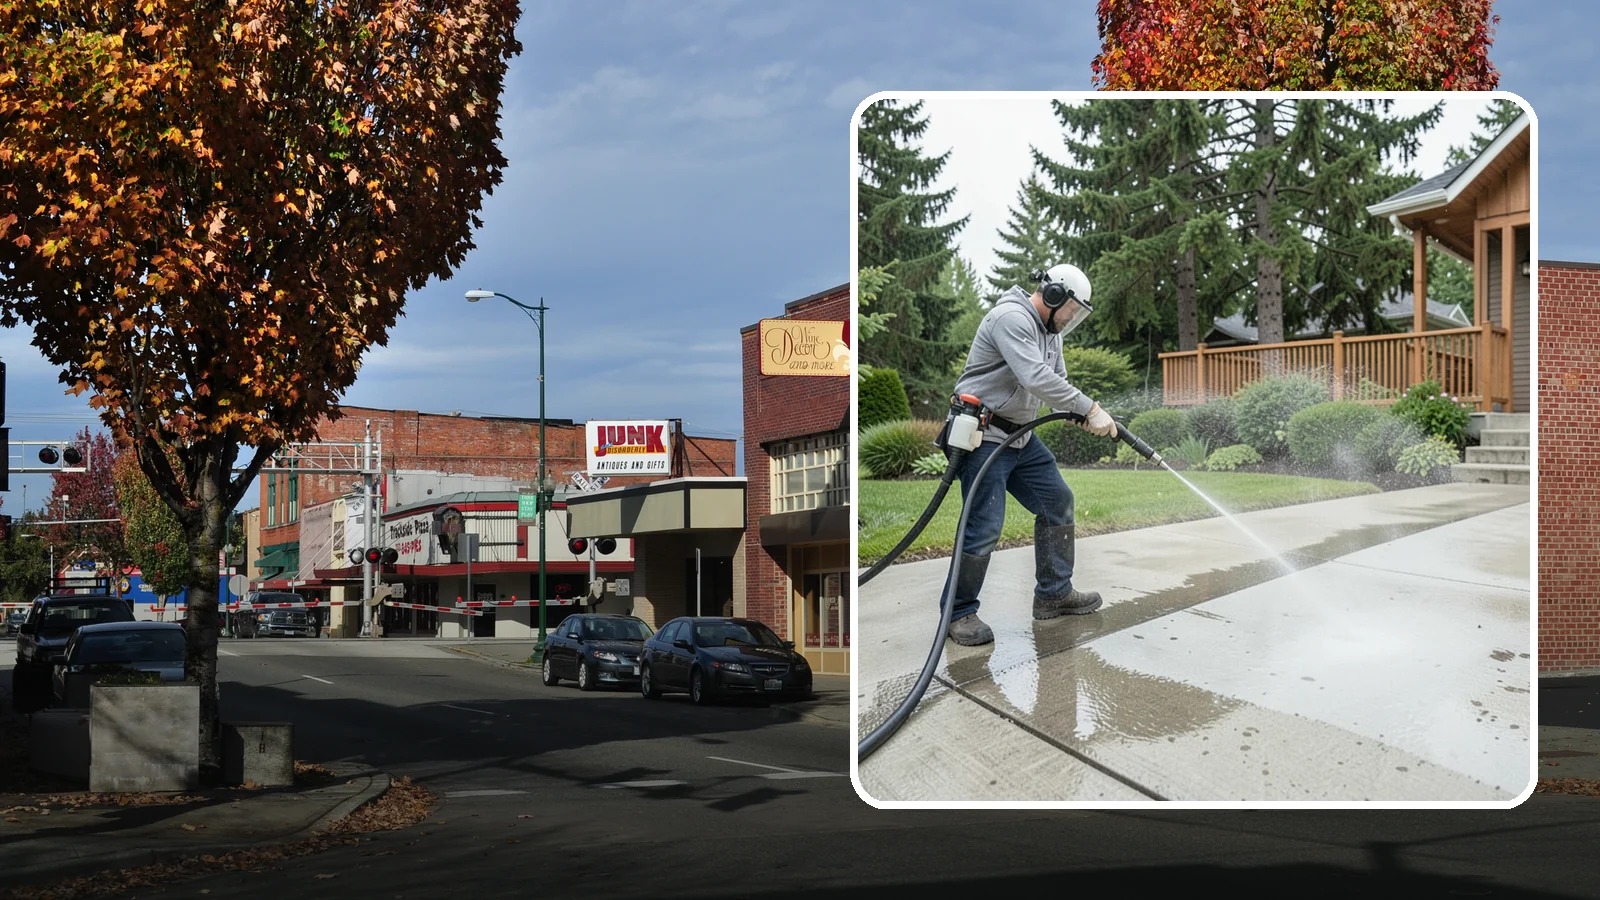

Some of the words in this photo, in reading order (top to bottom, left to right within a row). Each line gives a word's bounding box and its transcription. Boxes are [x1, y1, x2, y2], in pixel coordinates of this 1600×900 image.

[595, 425, 665, 457] JUNK
[607, 446, 646, 454] DISORDERLY
[597, 461, 628, 470] ANTIQUES
[631, 461, 644, 470] AND
[647, 460, 665, 469] GIFTS
[573, 473, 589, 491] RAIL
[390, 521, 413, 540] Trackside
[414, 519, 429, 535] Pizza
